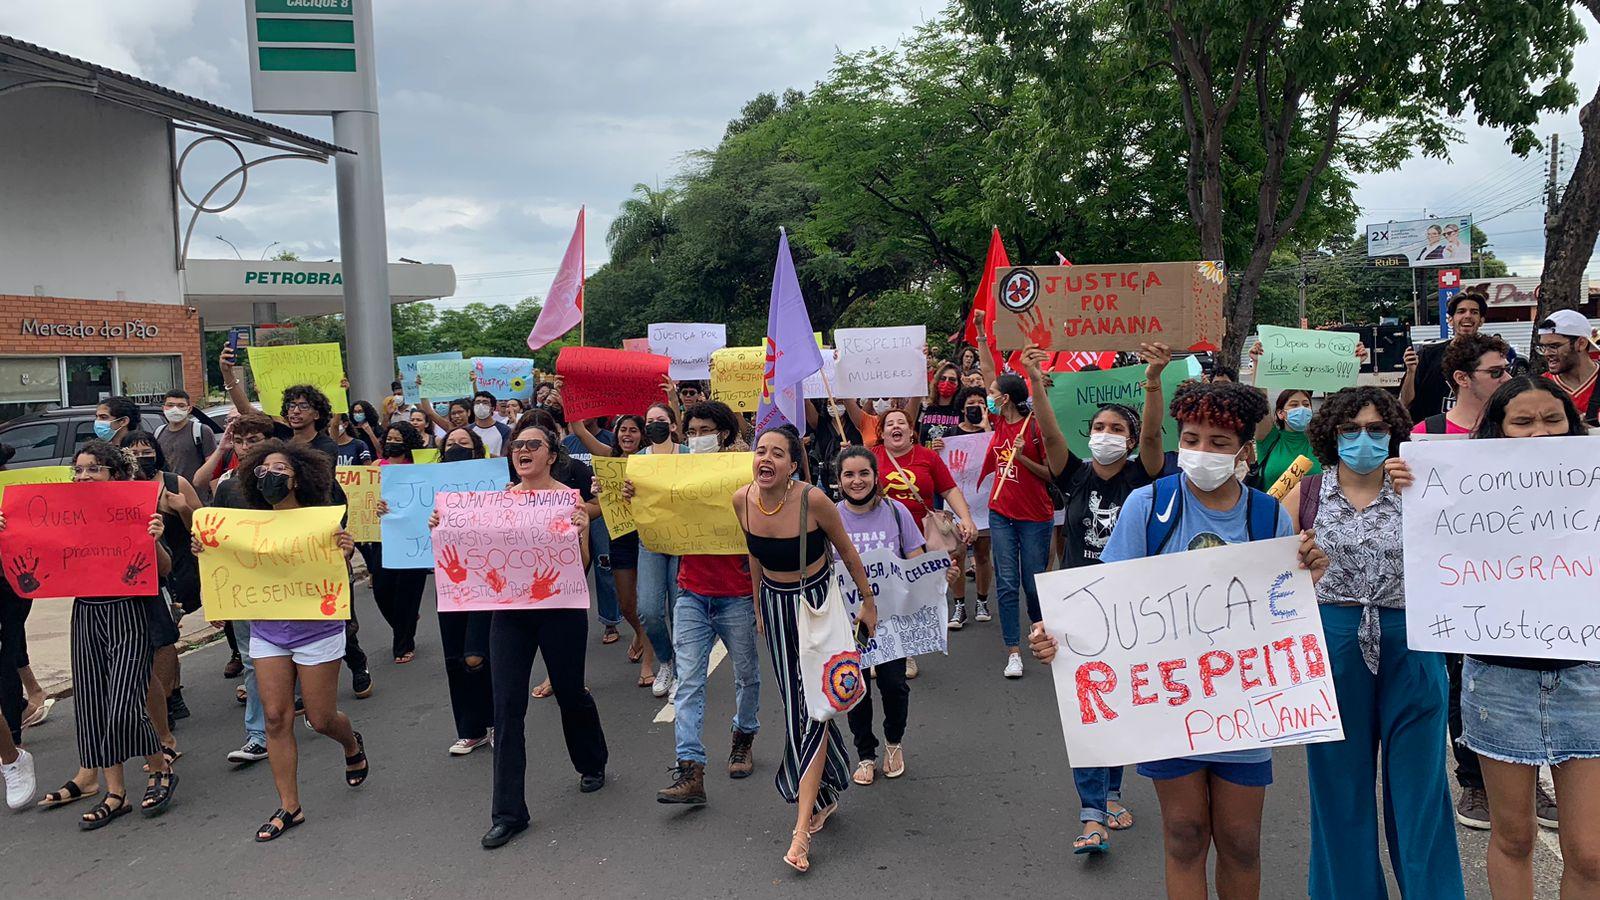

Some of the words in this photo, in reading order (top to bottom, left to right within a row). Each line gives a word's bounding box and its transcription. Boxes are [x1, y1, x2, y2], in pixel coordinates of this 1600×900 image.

[1371, 231, 1389, 241] 2X
[1045, 271, 1162, 295] JUSTIÇA
[1081, 294, 1119, 311] POR
[21, 318, 96, 338] Mercado
[100, 319, 123, 339] do
[124, 318, 159, 340] Pão
[1065, 316, 1163, 337] JANAINA
[843, 336, 912, 354] RESPEITA
[848, 369, 913, 383] MULHERES
[1077, 381, 1142, 405] NENHUMA
[1422, 467, 1449, 499] A
[446, 491, 514, 510] QUANTAS
[905, 558, 951, 583] CELEBRO
[1063, 576, 1258, 657] JUSTIÇA
[1075, 633, 1326, 725] RESPEITO
[1184, 708, 1250, 751] POR
[1254, 688, 1338, 740] JANA!
